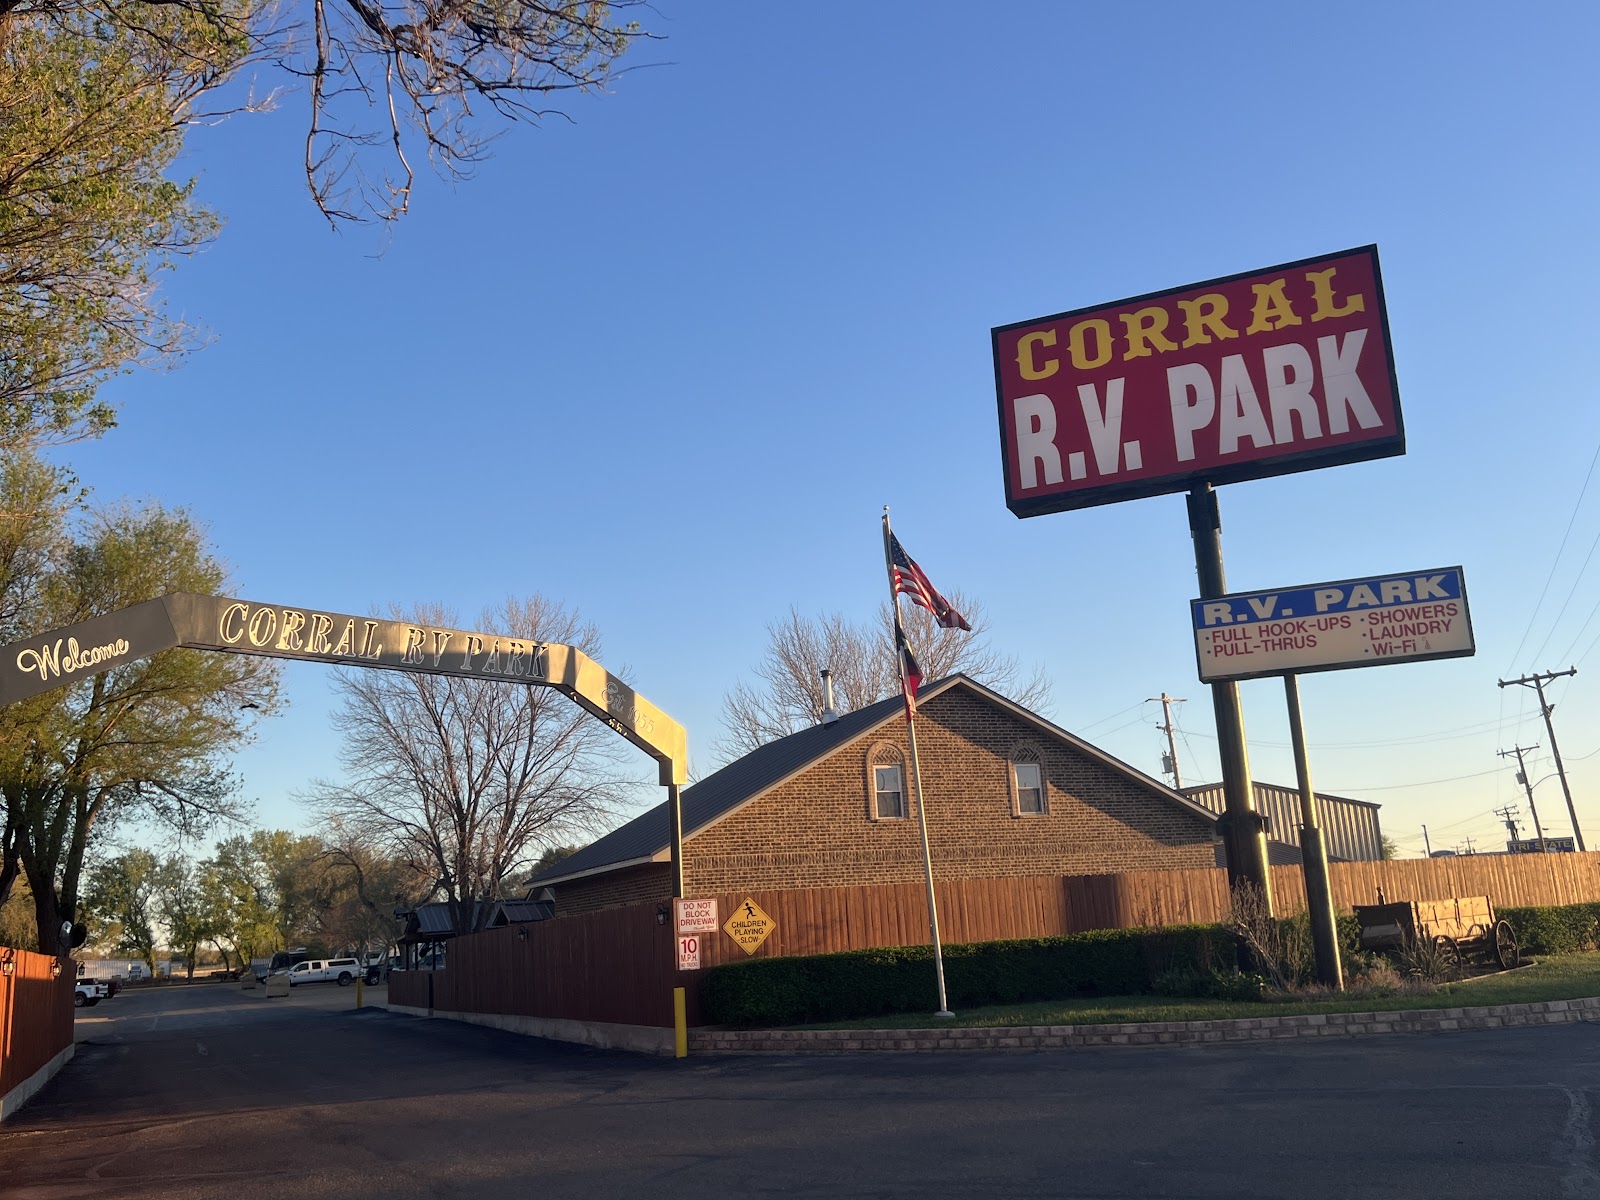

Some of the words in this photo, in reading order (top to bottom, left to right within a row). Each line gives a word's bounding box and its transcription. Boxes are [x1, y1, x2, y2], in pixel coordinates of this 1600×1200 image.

[1014, 266, 1365, 381] CORRAL
[1013, 377, 1143, 490] R.V.
[1166, 328, 1384, 463] PARK
[1203, 596, 1293, 626] R.V.
[1314, 574, 1450, 612] PARK
[1367, 602, 1458, 626] SHOWERS
[219, 602, 383, 661] CORRAL
[401, 627, 453, 667] RV
[460, 635, 549, 679] PARK
[1211, 627, 1253, 644] FULL
[1258, 615, 1352, 638] HOOK-UPS
[1369, 619, 1452, 641] LAUNDRY
[1213, 634, 1318, 658] PULL-THRUS
[1372, 638, 1417, 656] Wi-Fi
[16, 636, 129, 681] Welcome
[628, 706, 654, 733] 1955
[680, 918, 716, 926] DRIVEWAY
[685, 910, 710, 918] BLOCK
[731, 920, 767, 928] CHILDREN
[734, 928, 764, 936] PLAYING
[681, 938, 697, 954] 10
